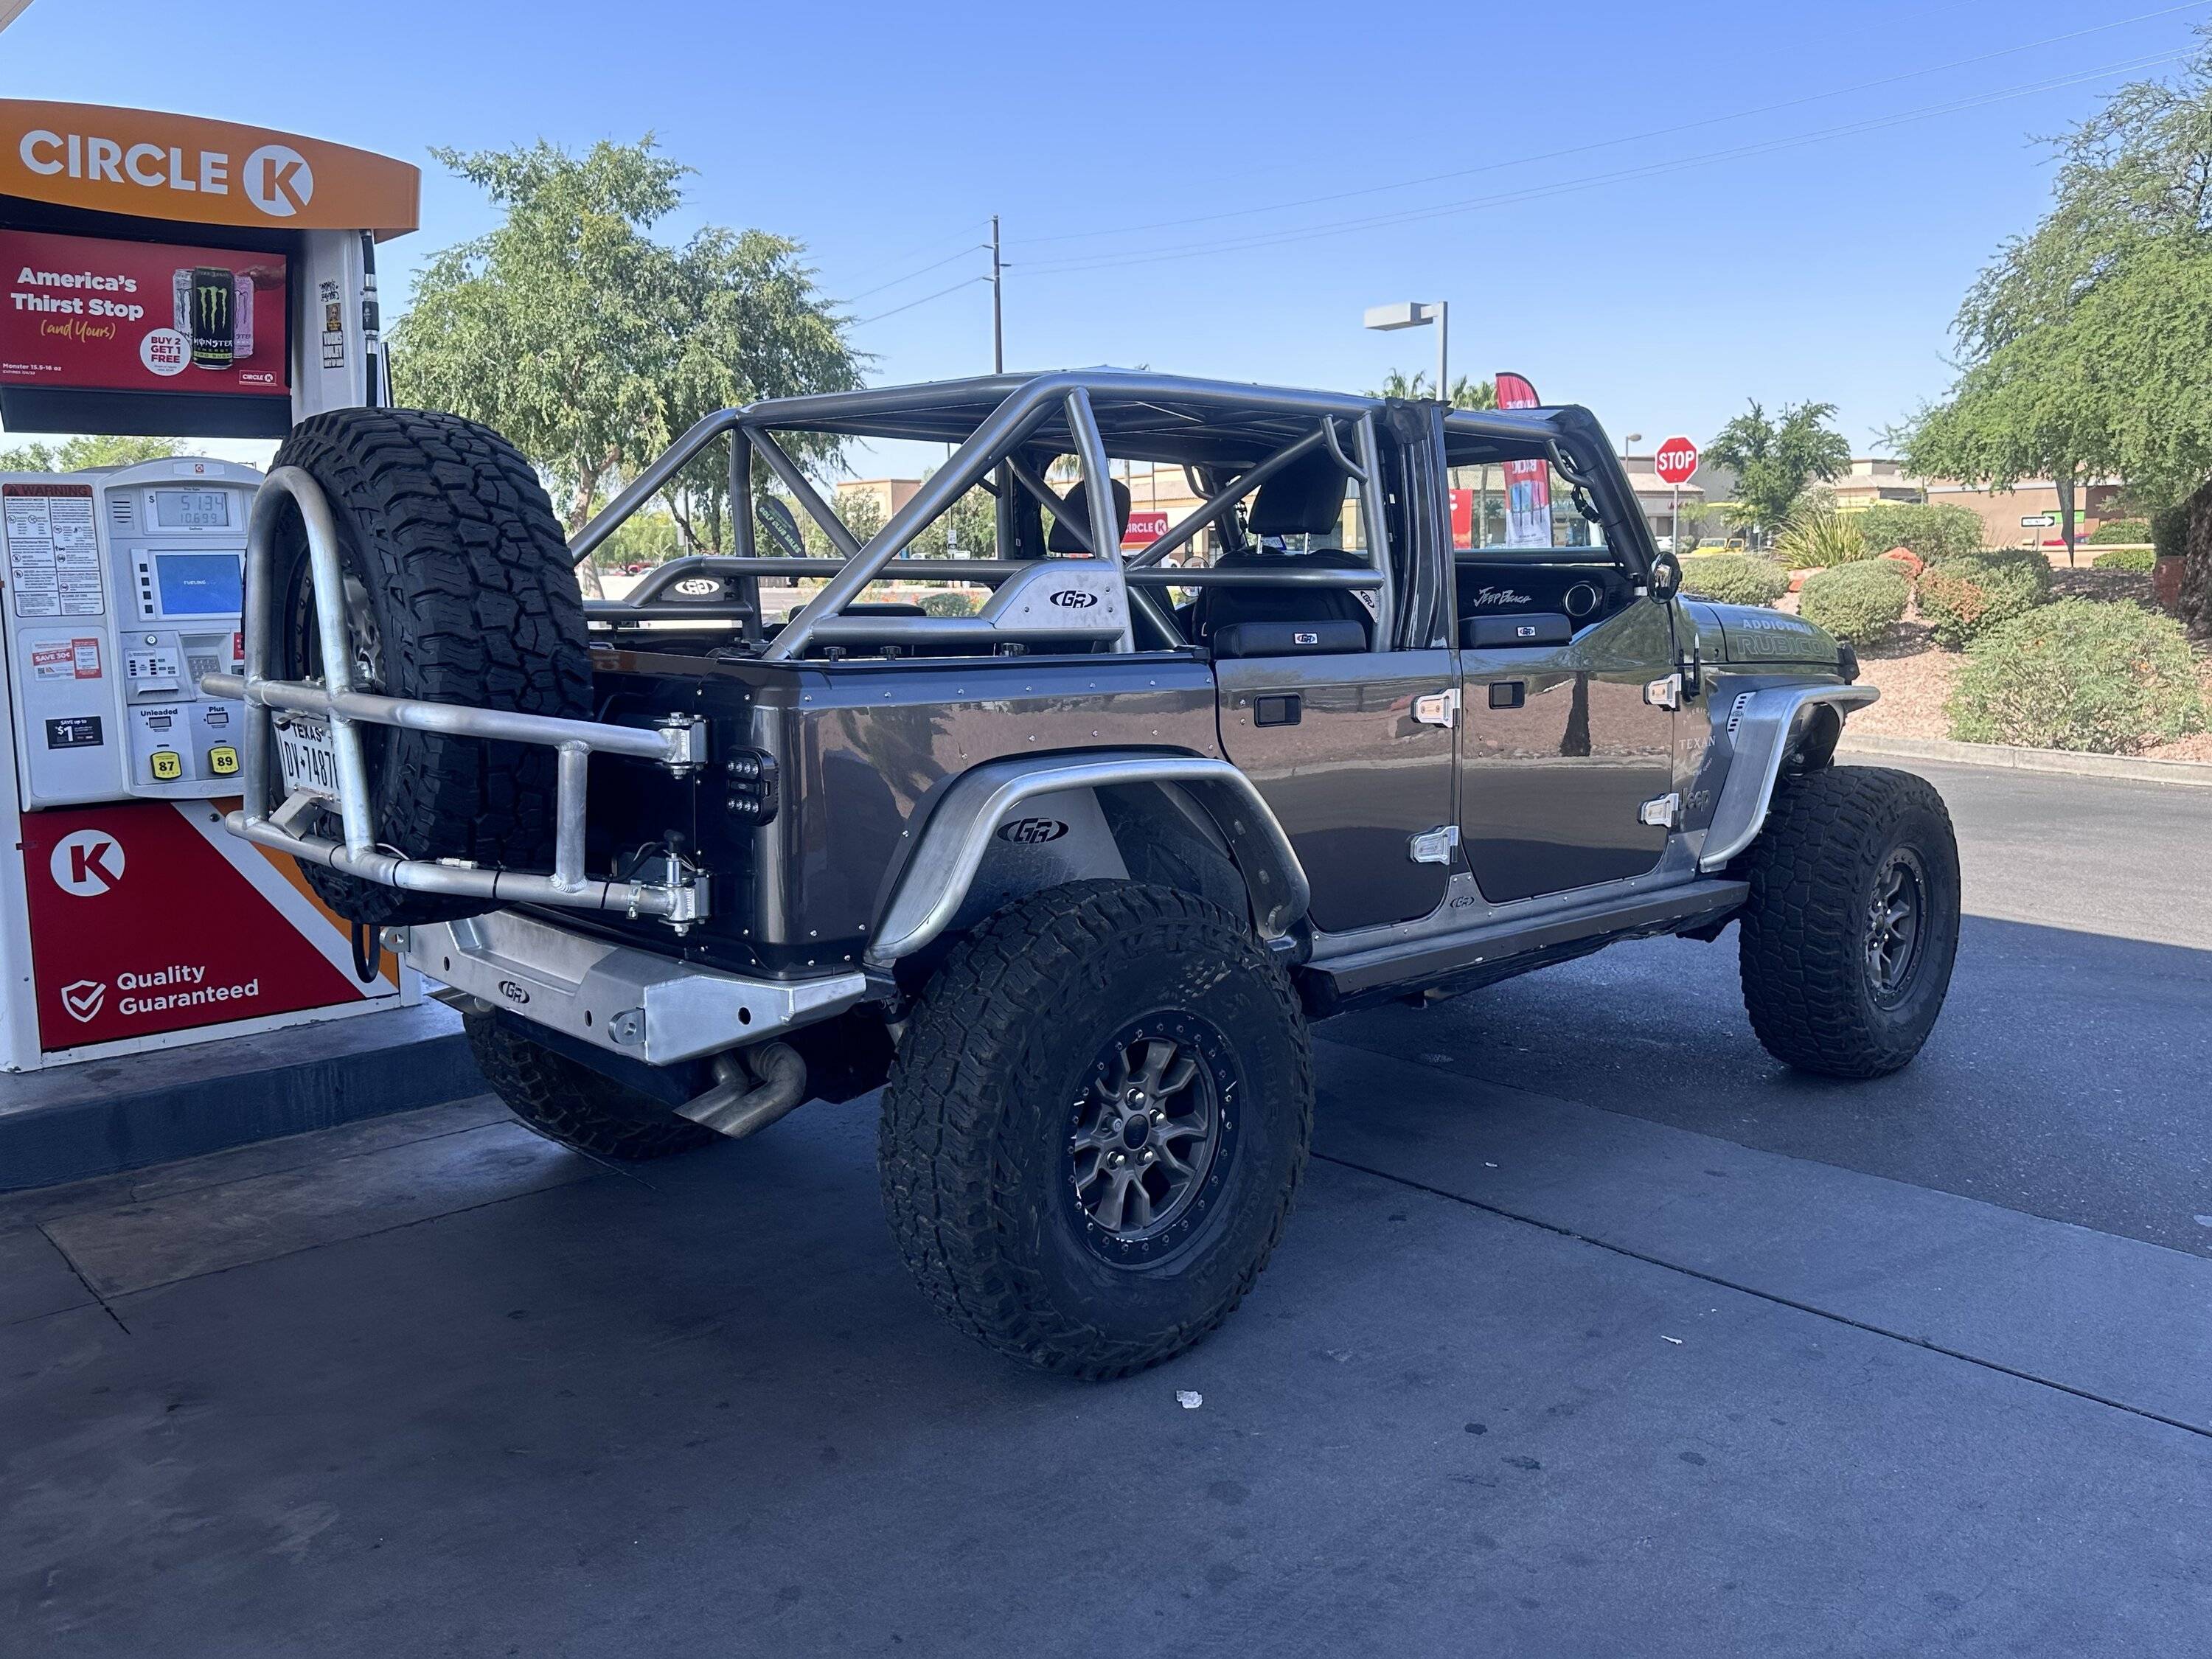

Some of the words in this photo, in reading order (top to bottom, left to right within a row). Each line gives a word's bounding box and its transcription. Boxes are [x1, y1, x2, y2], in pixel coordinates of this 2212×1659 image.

[20, 129, 228, 195] CIRCLE
[254, 152, 310, 215] K
[17, 267, 137, 293] America's
[10, 292, 83, 315] Thirst
[88, 299, 144, 321] Stop
[41, 319, 74, 340] (and
[75, 321, 116, 343] Yours)
[151, 336, 172, 344] BUY
[151, 345, 173, 354] GET
[151, 354, 181, 363] FREE
[1658, 451, 1694, 471] STOP
[24, 486, 88, 496] WARNING
[759, 507, 774, 521] GOLF
[784, 534, 801, 554] SALES
[1060, 590, 1088, 609] GR
[35, 654, 55, 662] SAVE
[140, 709, 178, 717] Unleaded
[291, 722, 321, 742] TEXAS
[1679, 735, 1716, 750] TEXAN
[159, 762, 175, 771] 87
[217, 756, 233, 767] 89
[1680, 787, 1709, 812] Jeep
[1009, 817, 1057, 844] GR
[61, 835, 122, 893] K
[116, 964, 205, 990] Quality
[119, 978, 259, 1015] Guaranteed
[504, 981, 524, 1004] GR
